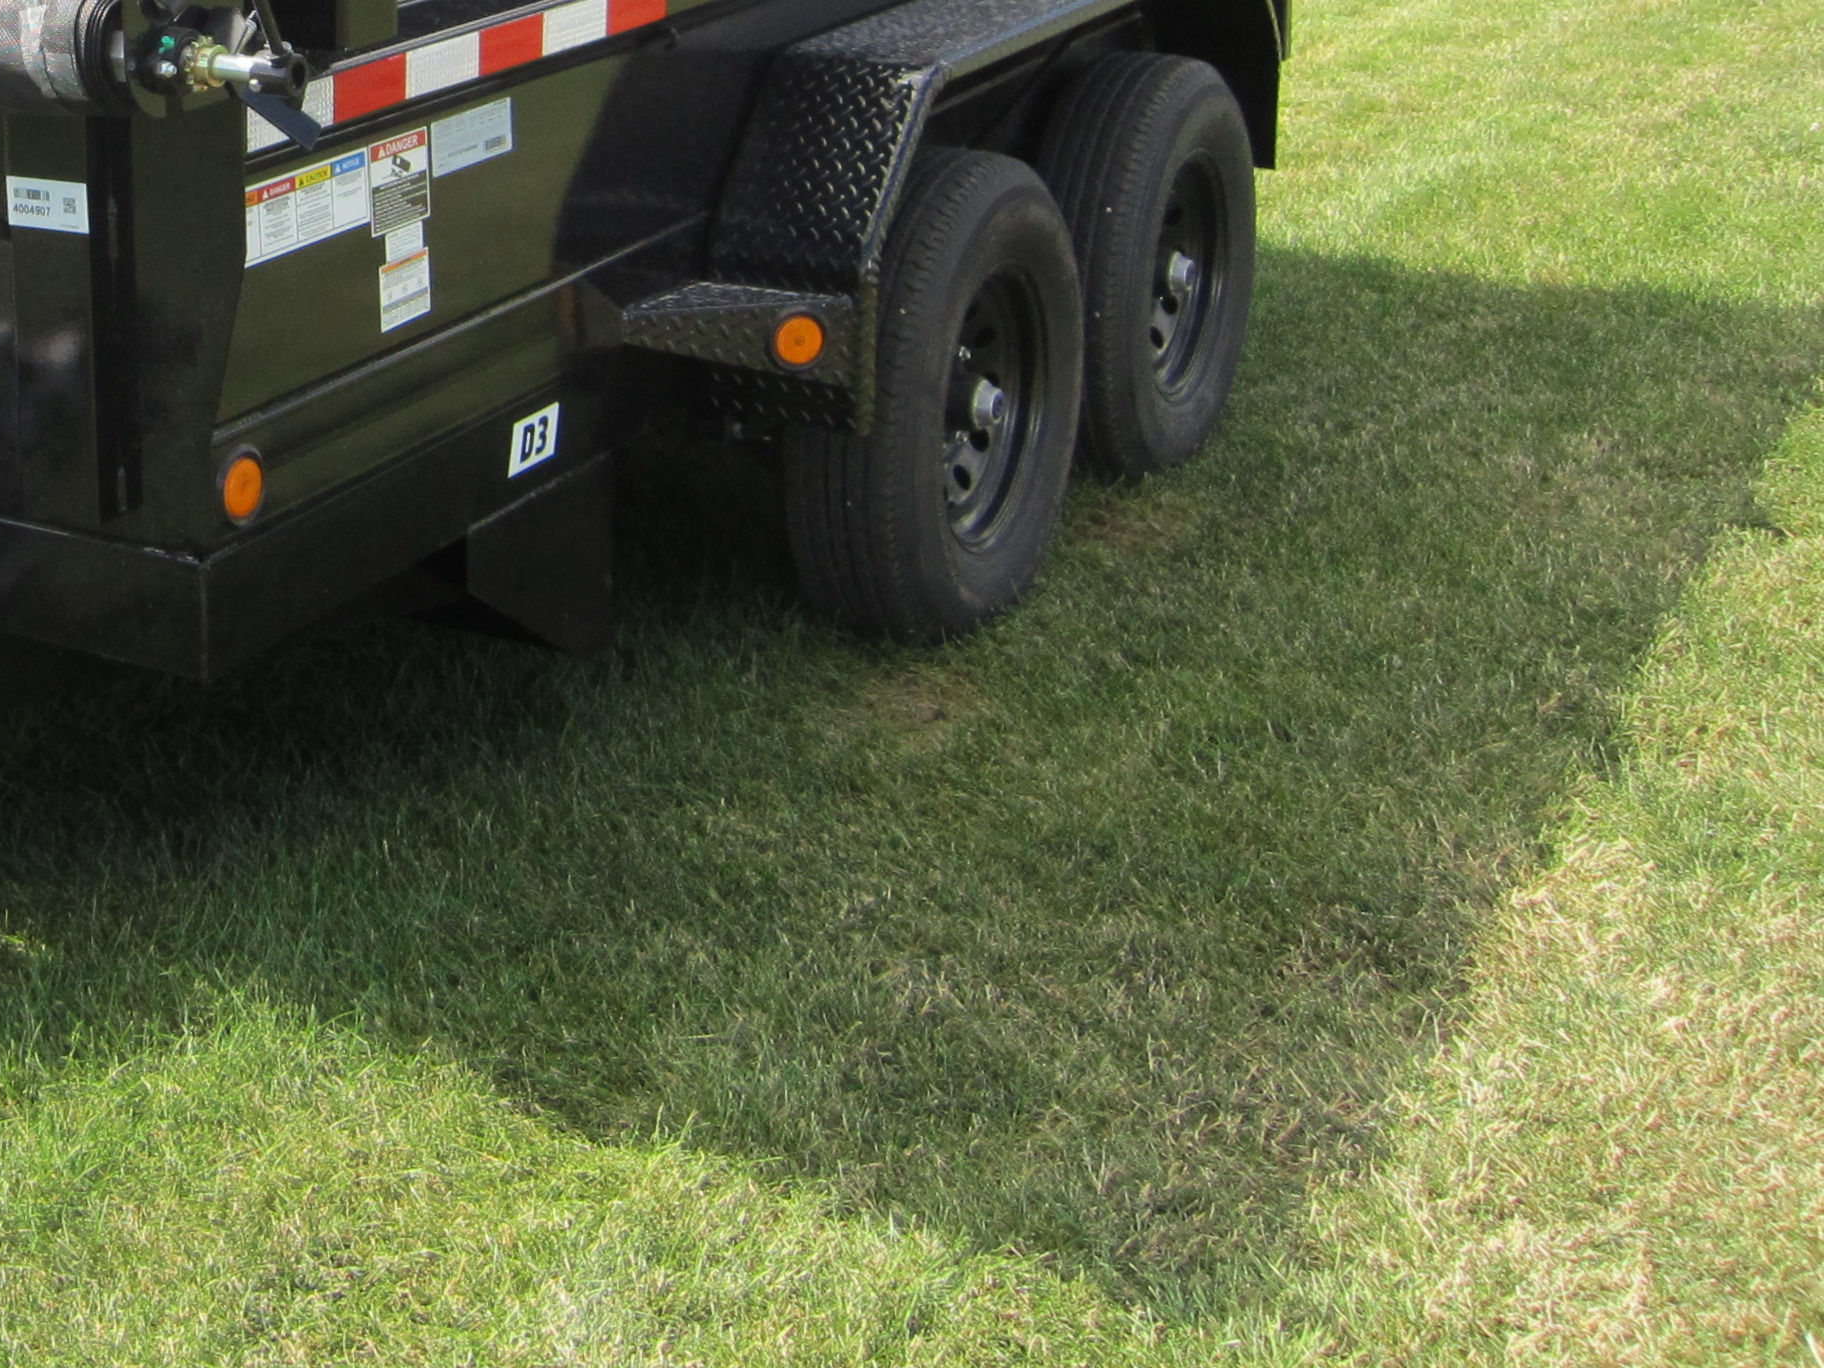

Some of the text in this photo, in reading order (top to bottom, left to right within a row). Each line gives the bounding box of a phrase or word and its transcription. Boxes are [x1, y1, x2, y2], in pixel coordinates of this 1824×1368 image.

[385, 134, 419, 157] DANGER
[269, 181, 292, 196] DANGER
[519, 415, 549, 464] D3
